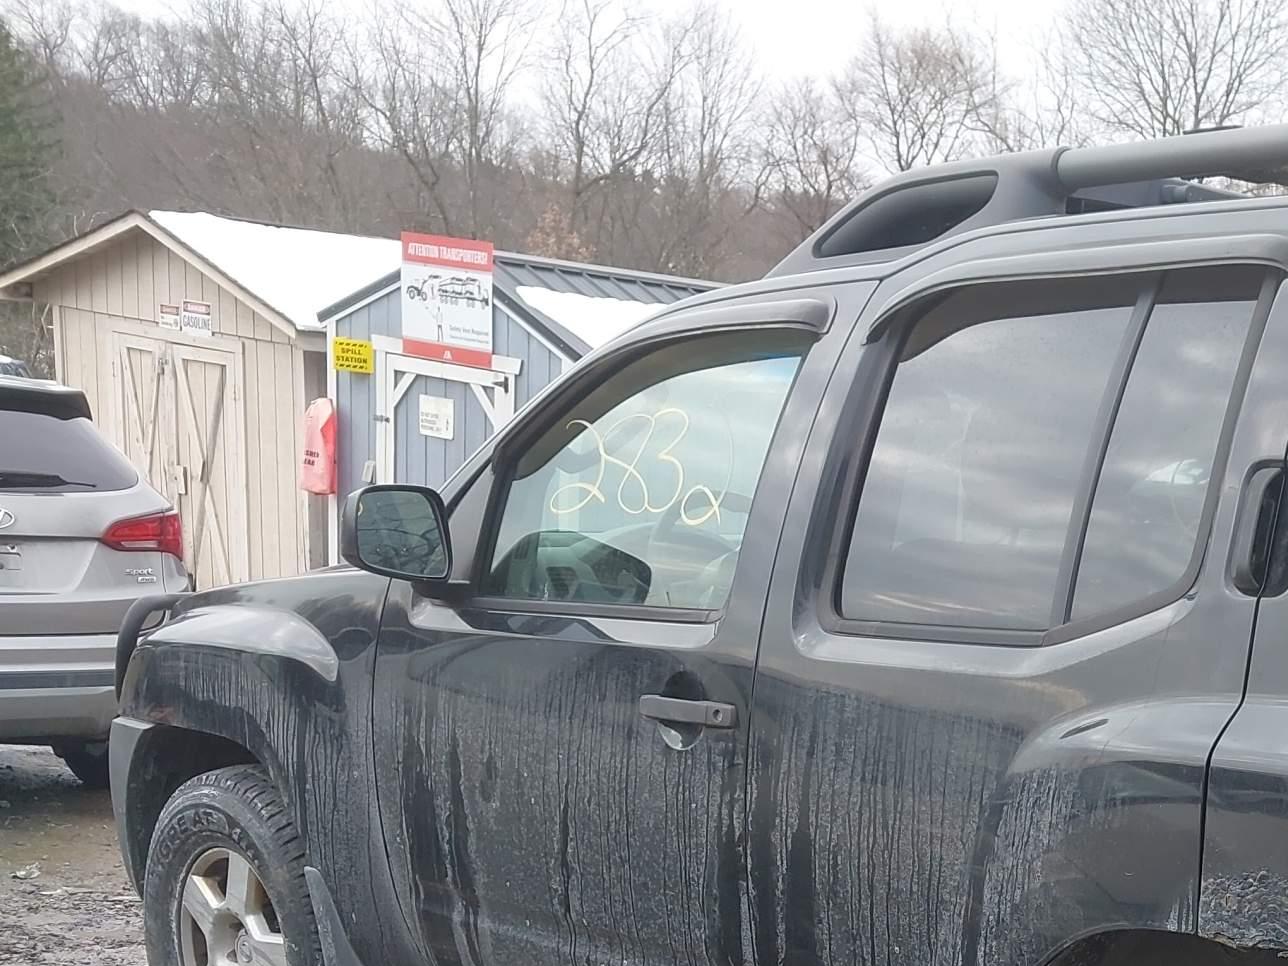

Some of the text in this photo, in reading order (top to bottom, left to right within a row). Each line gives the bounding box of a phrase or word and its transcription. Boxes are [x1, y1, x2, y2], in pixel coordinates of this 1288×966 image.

[407, 242, 439, 258] ATTENTION
[183, 314, 210, 330] GASOLINE
[341, 347, 362, 355] SPILL
[336, 355, 368, 364] STATION
[124, 567, 154, 576] Sport
